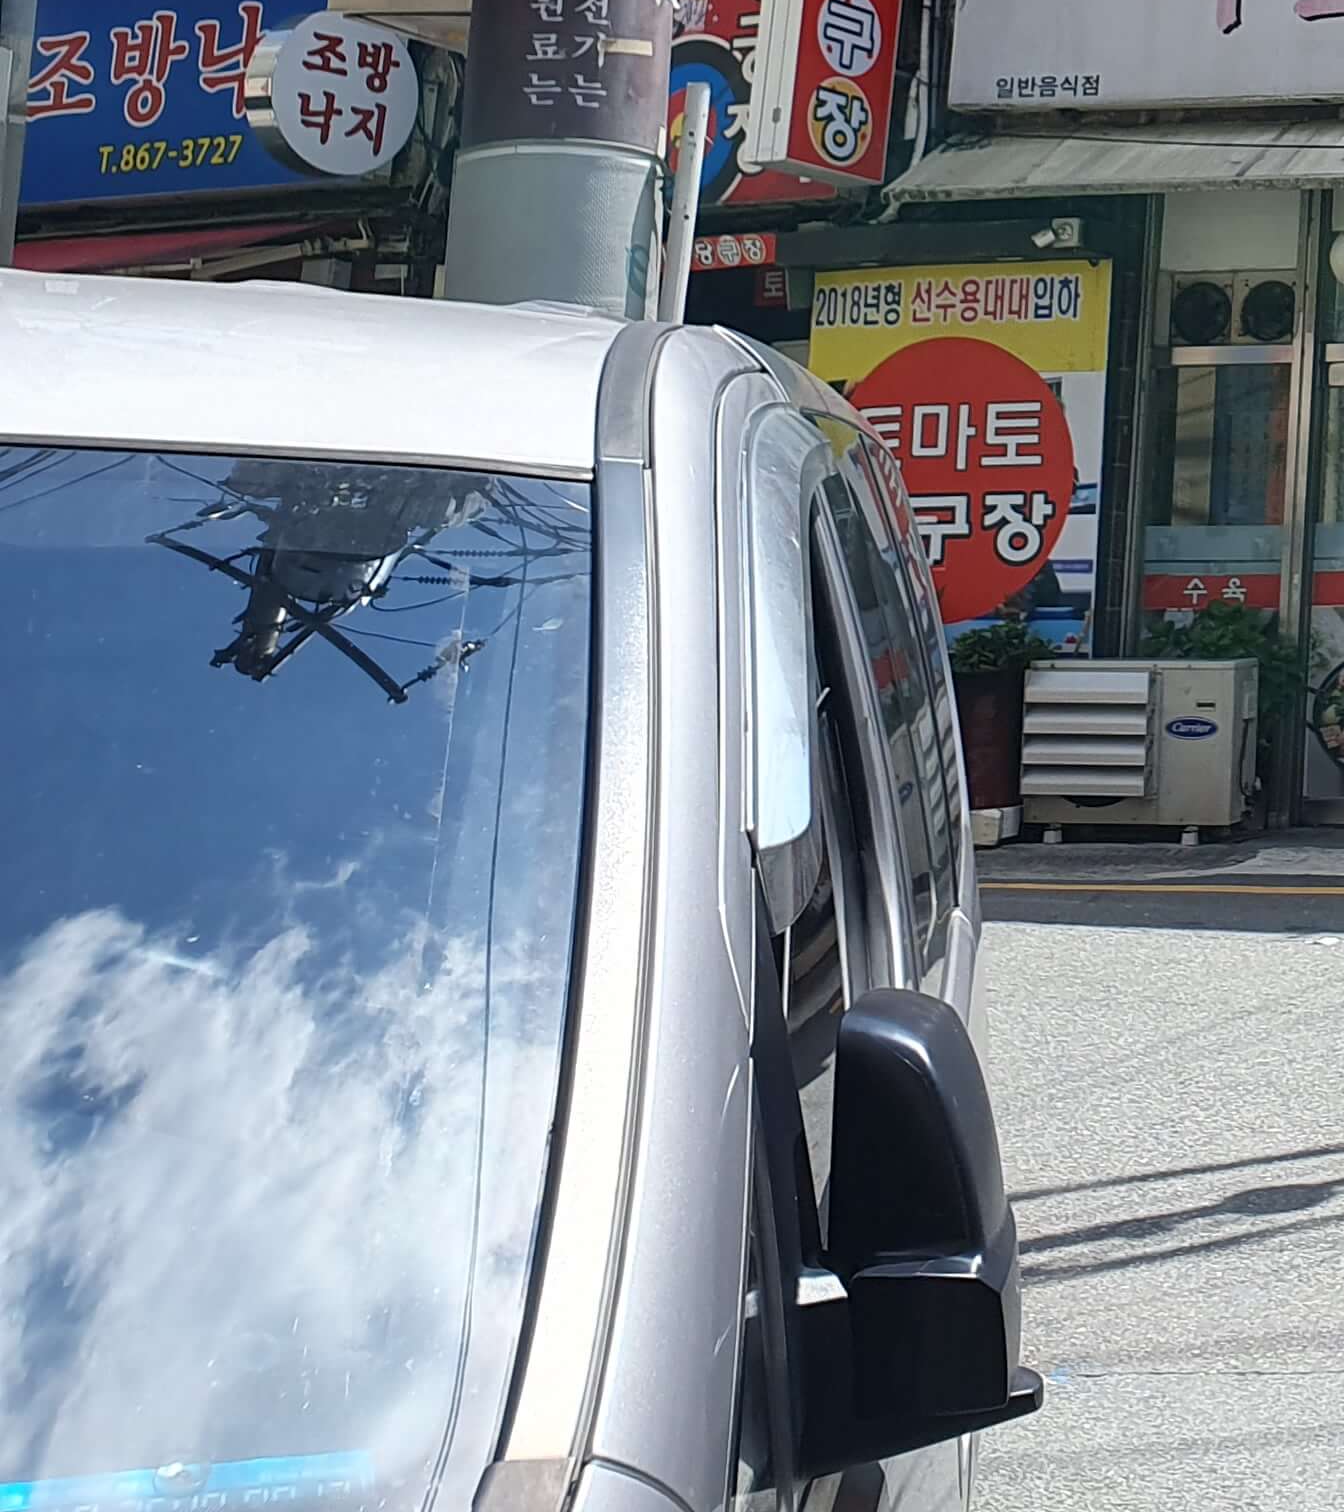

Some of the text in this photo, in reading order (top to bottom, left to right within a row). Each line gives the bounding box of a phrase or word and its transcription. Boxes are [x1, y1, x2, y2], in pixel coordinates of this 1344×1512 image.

[302, 31, 400, 94] 조방
[994, 74, 1101, 99] 일반음식점
[298, 89, 389, 158] 낙지
[99, 134, 243, 175] T.867-3727
[815, 281, 902, 327] 2018년형
[1183, 576, 1248, 604] 수육
